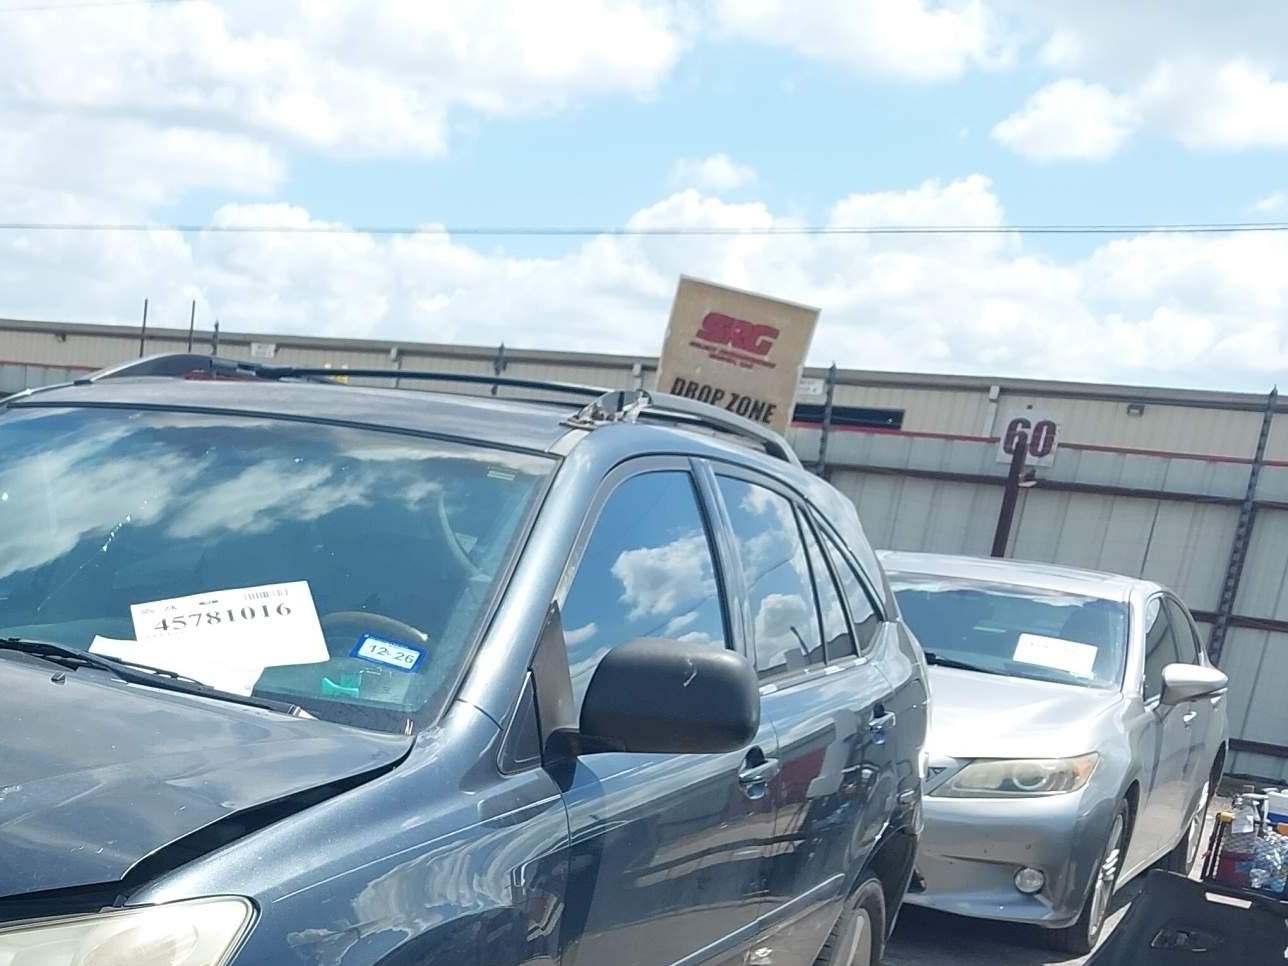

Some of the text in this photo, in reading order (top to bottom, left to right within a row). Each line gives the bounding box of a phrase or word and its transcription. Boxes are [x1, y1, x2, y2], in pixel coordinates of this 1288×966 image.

[670, 377, 777, 424] DROP ZONE
[1002, 417, 1057, 457] 60
[153, 602, 293, 632] 45781016
